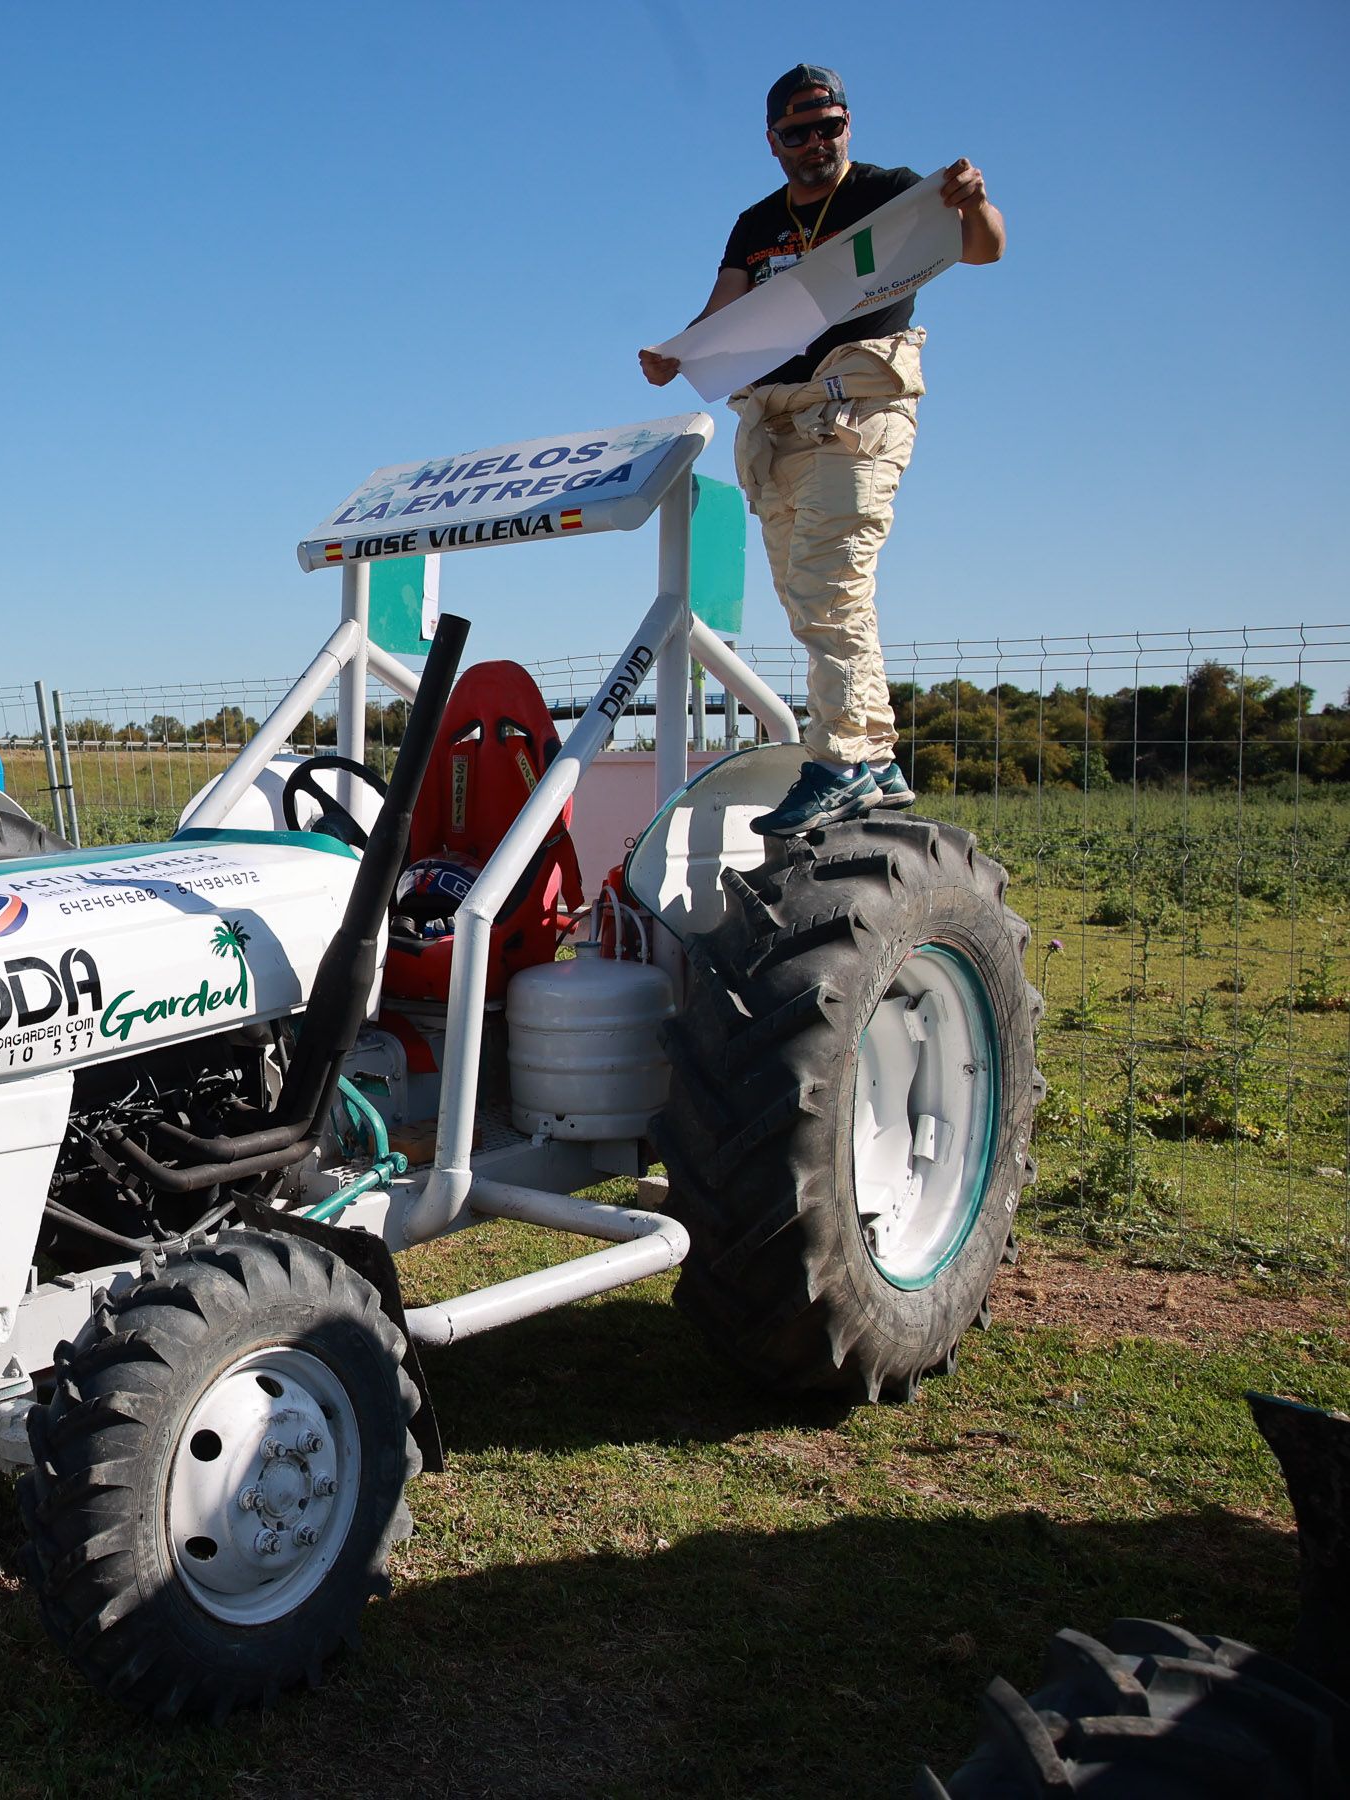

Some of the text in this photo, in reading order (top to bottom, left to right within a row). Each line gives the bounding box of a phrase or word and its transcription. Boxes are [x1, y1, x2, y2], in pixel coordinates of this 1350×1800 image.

[841, 224, 876, 277] 1
[878, 286, 890, 294] de
[889, 284, 910, 297] FEST
[409, 441, 609, 490] HIELOS
[333, 462, 633, 526] LA ENTREGA
[348, 513, 555, 559] JOSÉ VILLENA
[597, 646, 653, 722] DAVID
[455, 763, 466, 824] Sabelt
[9, 854, 219, 891] ACTIVA EXPRESS
[59, 888, 158, 915] 642464680
[177, 871, 260, 895] 674984872
[121, 876, 142, 884] DE
[100, 979, 247, 1042] Garden
